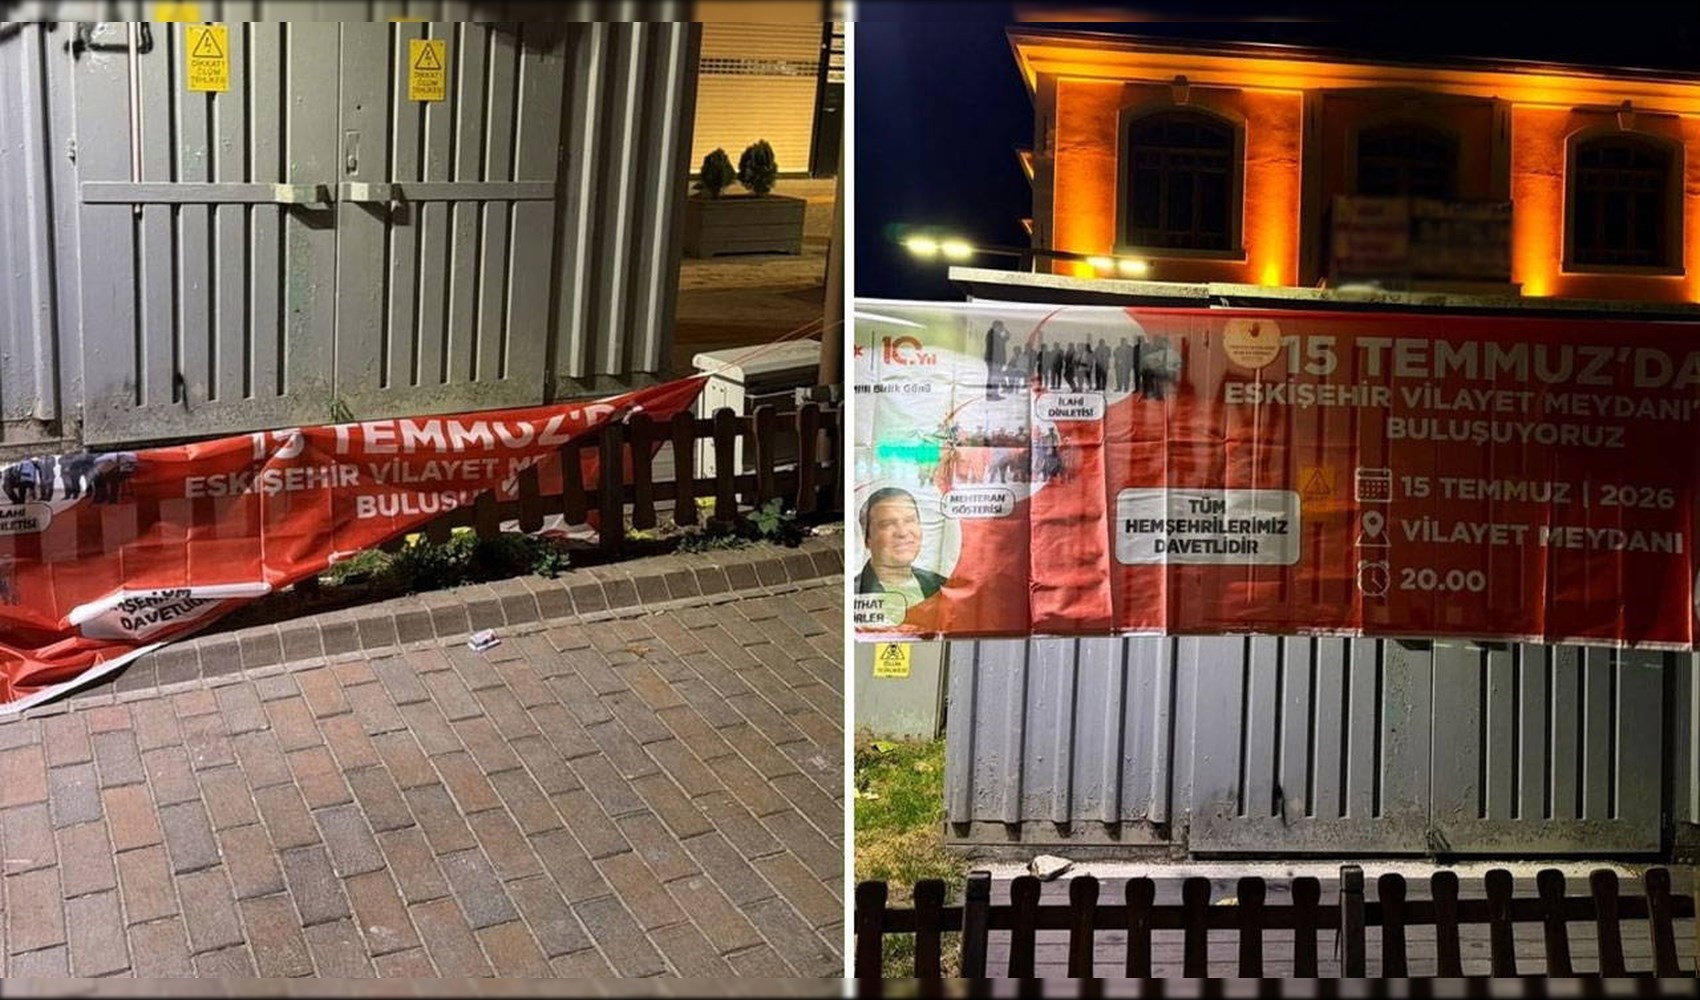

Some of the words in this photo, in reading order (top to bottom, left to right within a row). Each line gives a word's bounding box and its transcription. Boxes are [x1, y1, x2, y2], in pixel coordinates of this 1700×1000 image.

[1280, 334, 1338, 375] 15
[1224, 378, 1390, 409] ESKİŞEHİR
[1400, 382, 1535, 414] VİLAYET
[1386, 416, 1626, 448] BULUŞUYORUZ
[184, 459, 360, 497] ESKİŞEHİR
[368, 457, 499, 485] VİLAYET
[1401, 475, 1430, 498] 15
[1439, 477, 1571, 503] TEMMUZ
[1600, 484, 1675, 509] 2026
[1188, 496, 1226, 514] TÜM
[1125, 517, 1288, 536] HEMŞEHRİLERİMİZ
[1401, 515, 1529, 545] VİLAYET
[1539, 525, 1683, 554] MEYDANI
[1154, 538, 1258, 555] DAVETLİDİR
[1400, 567, 1486, 592] 20.00
